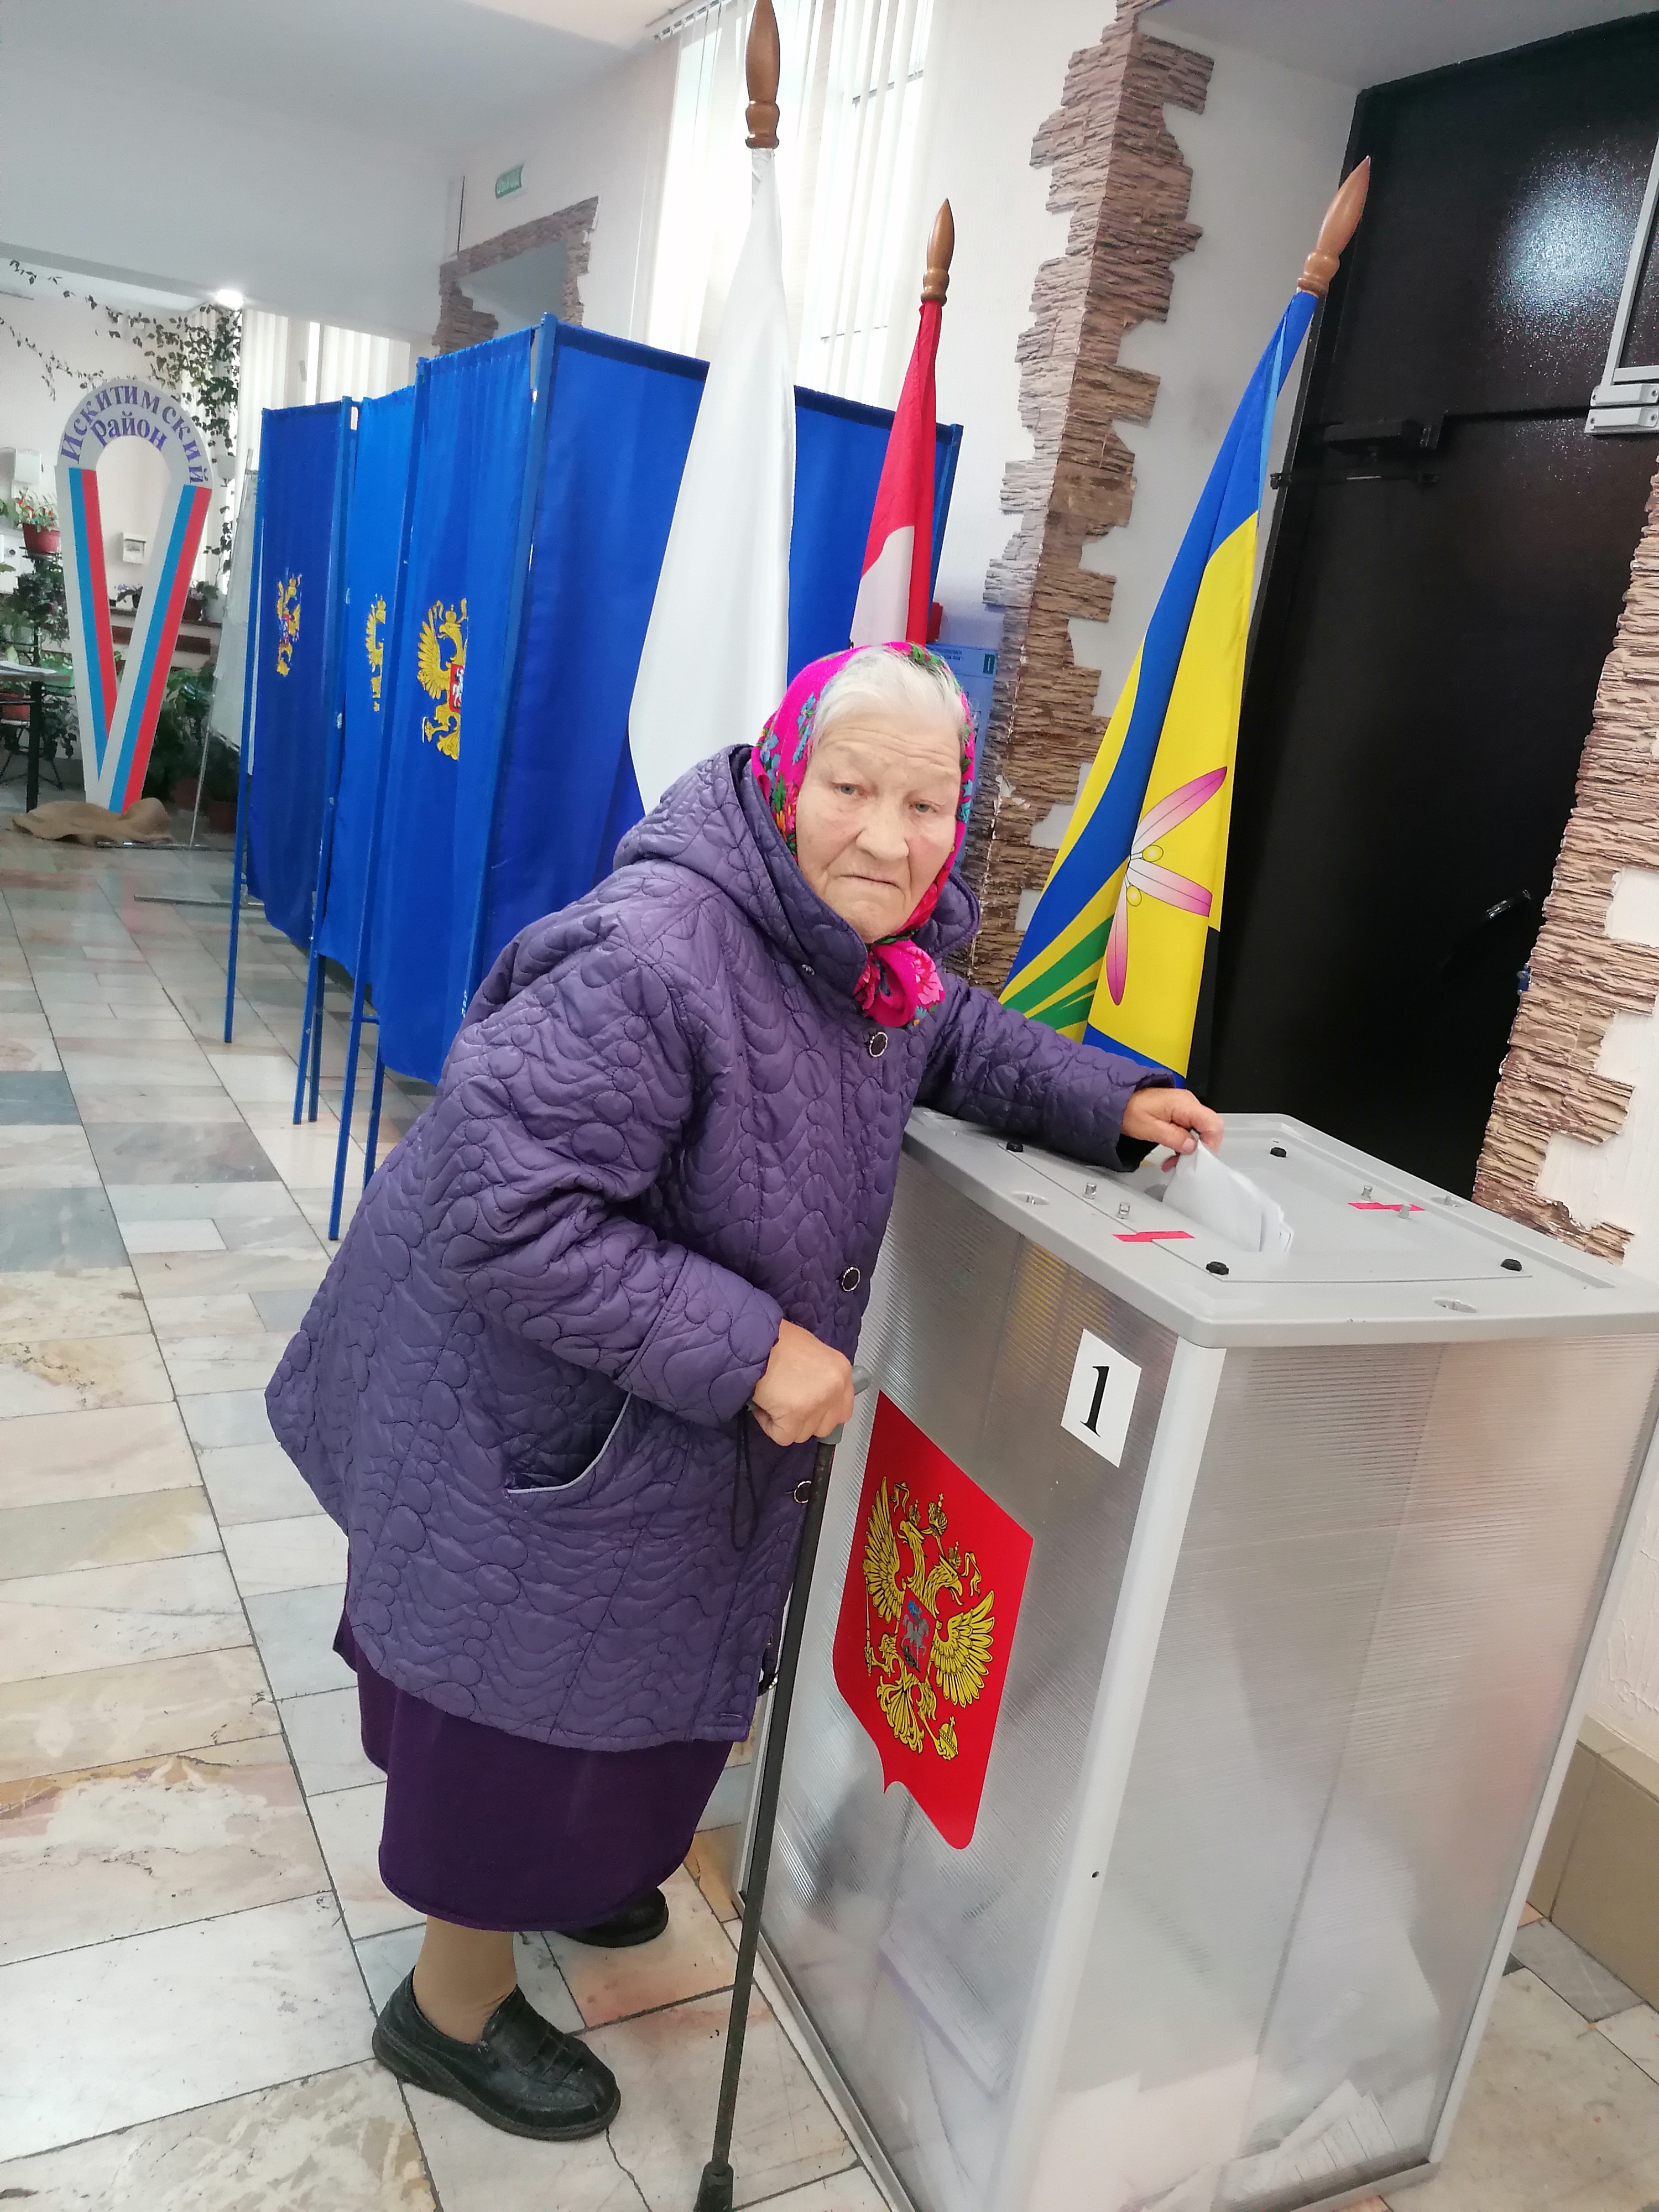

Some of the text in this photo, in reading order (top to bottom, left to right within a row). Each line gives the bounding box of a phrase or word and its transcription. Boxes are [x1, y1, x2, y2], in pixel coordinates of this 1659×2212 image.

[60, 385, 208, 483] Искитимский
[91, 410, 167, 451] район
[1079, 1365, 1110, 1438] 1
